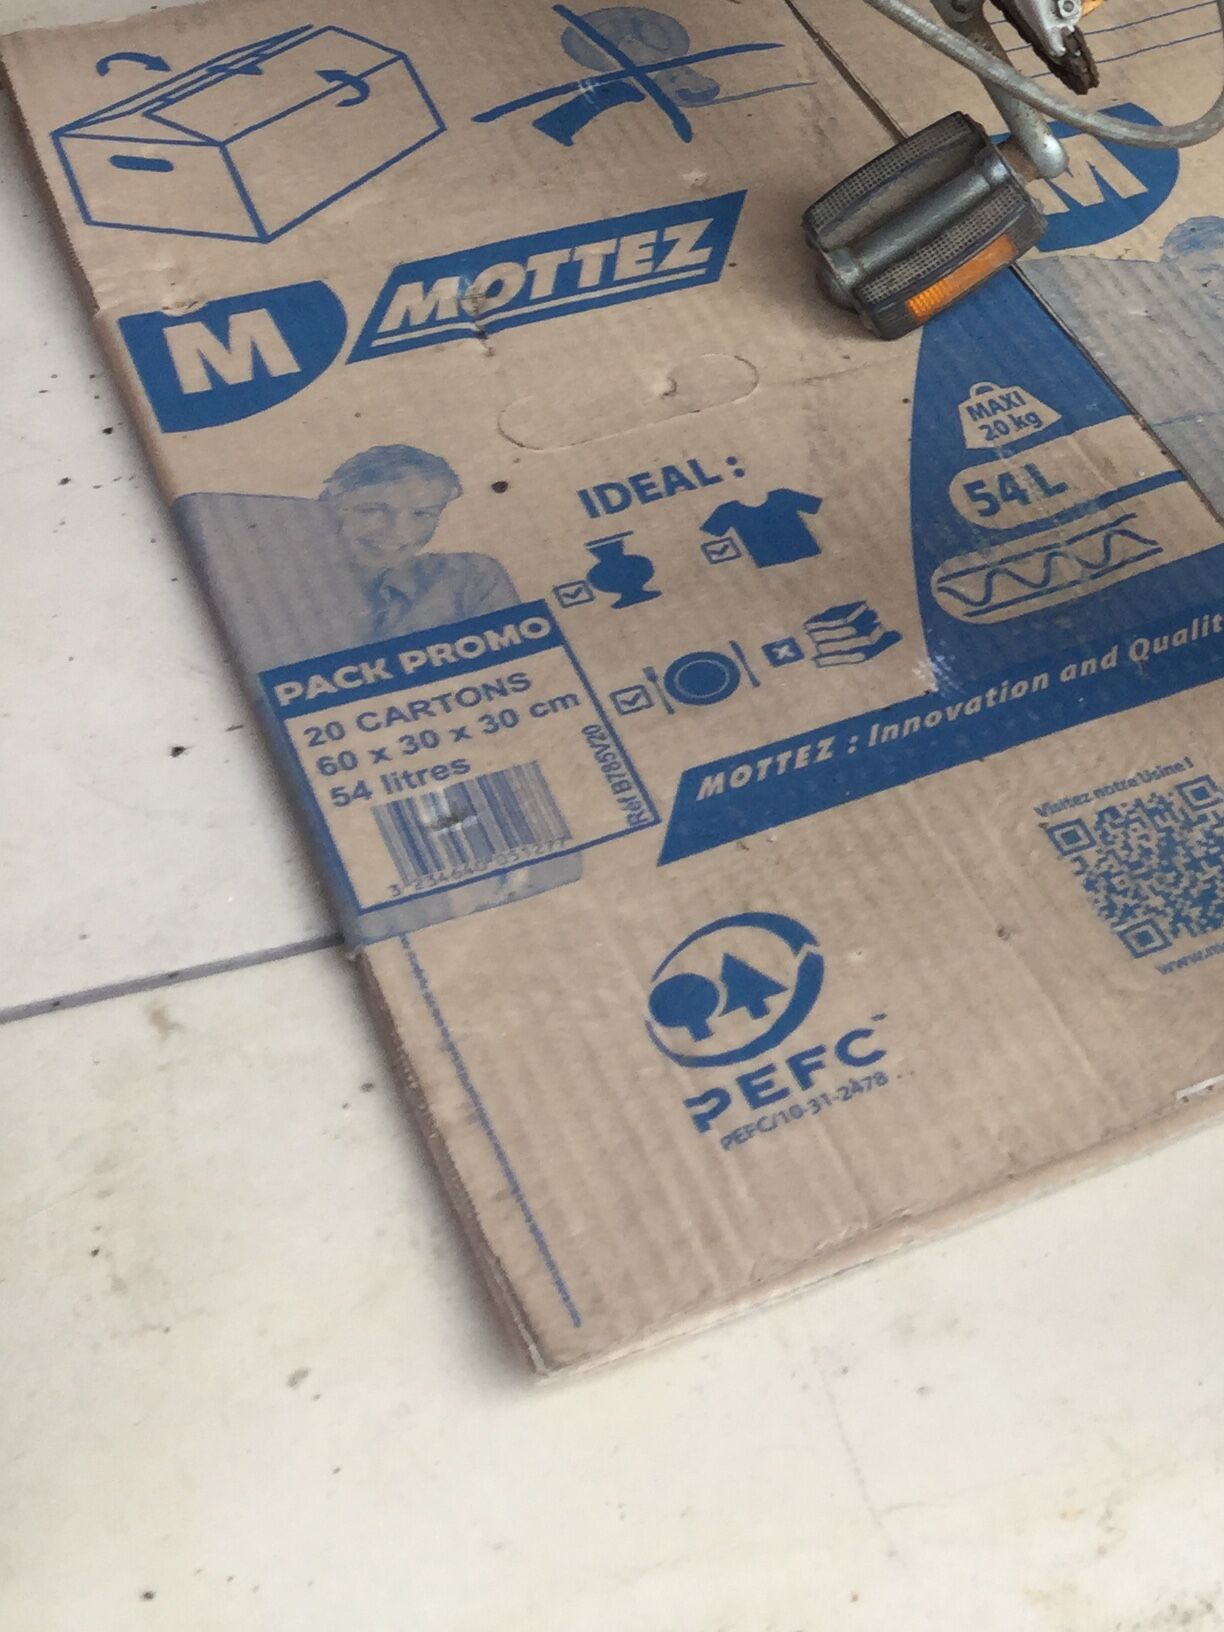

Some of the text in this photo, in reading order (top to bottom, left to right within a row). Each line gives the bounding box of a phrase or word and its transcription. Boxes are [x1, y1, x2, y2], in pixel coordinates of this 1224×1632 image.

[162, 218, 714, 395] M MOTTEZ
[966, 390, 1027, 421] MAXI
[978, 411, 1043, 441] 20 kg
[273, 617, 551, 708] PACK PROMO
[303, 671, 532, 747] 20 CARTONS
[315, 692, 583, 777] 60 x 30 x 30 cm
[695, 735, 836, 801] MOTTEZ
[867, 671, 1050, 748] Innovation
[1059, 644, 1119, 683] and
[329, 758, 471, 808] 54 litres
[1033, 792, 1093, 817] Visitez
[1092, 777, 1139, 799] notre
[683, 1027, 887, 1134] PEFC
[719, 1070, 889, 1151] PEFC/10-31-2478
